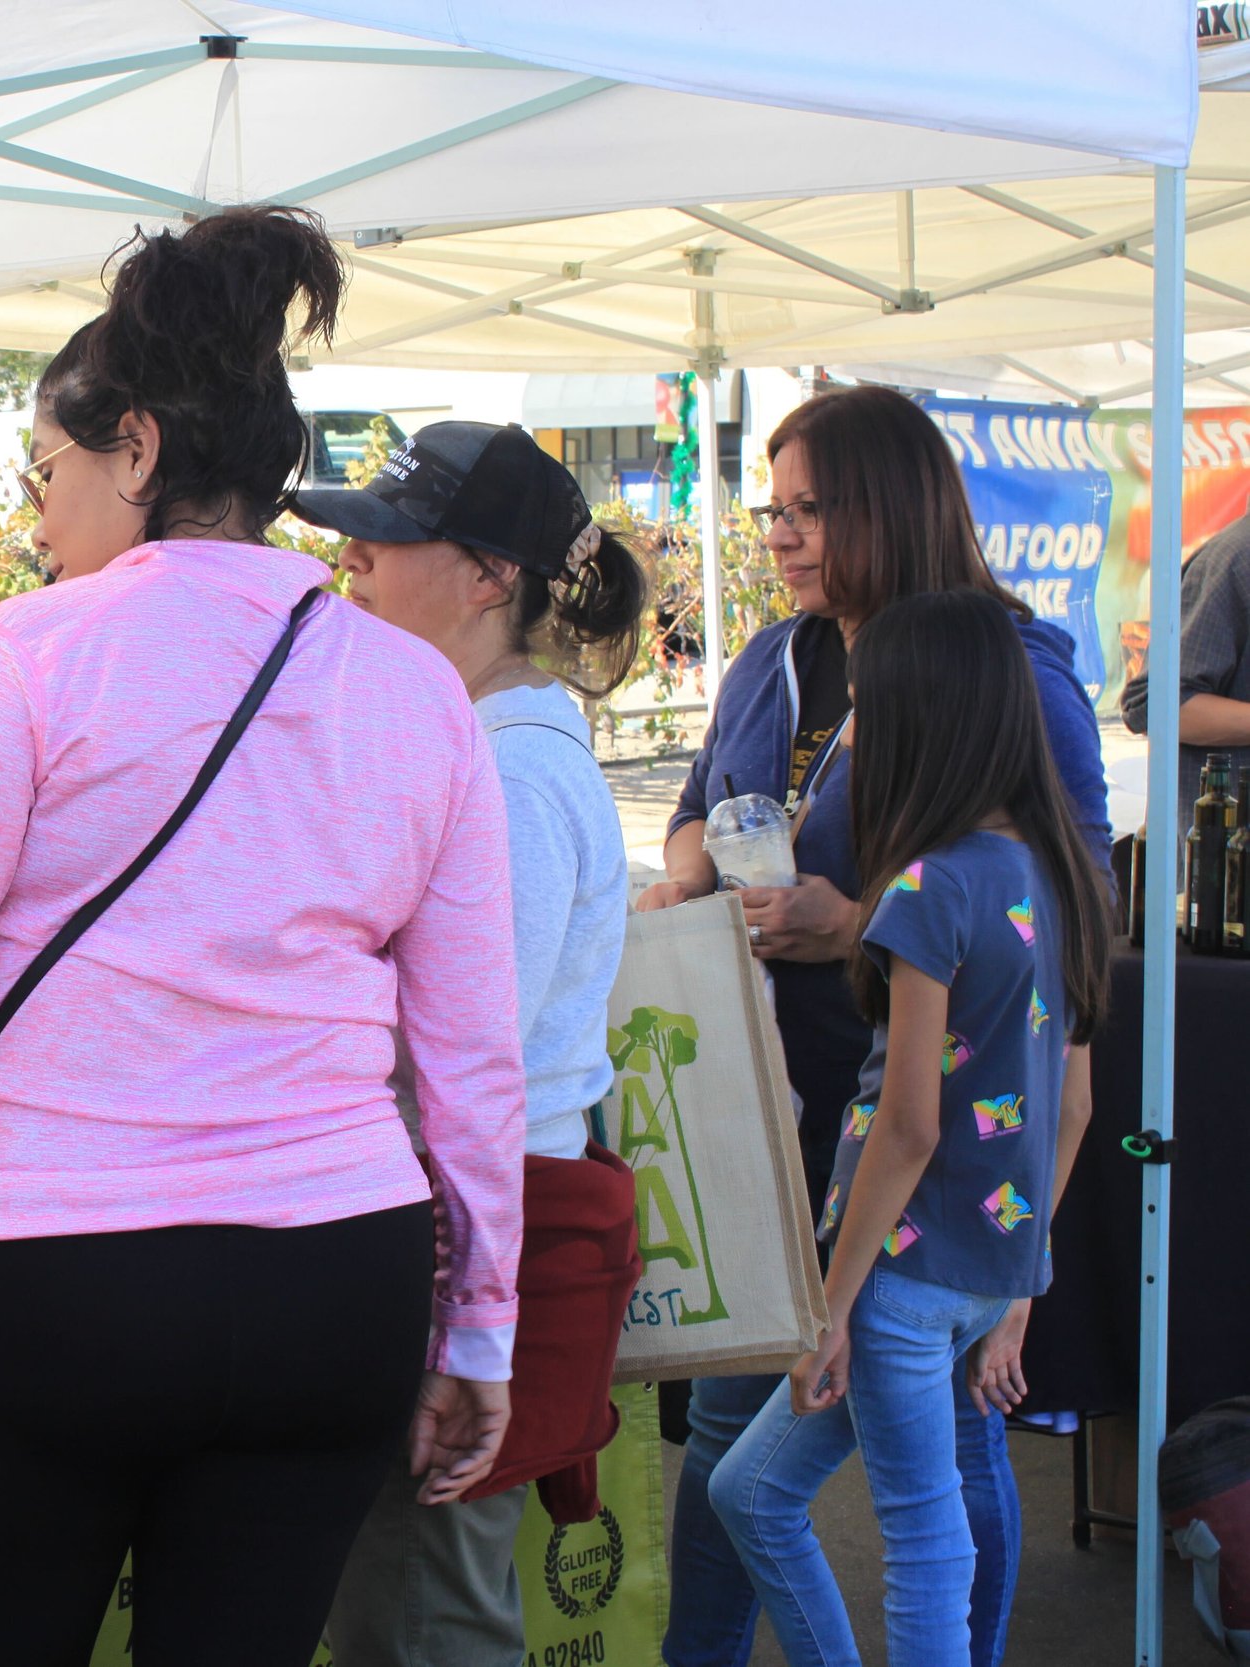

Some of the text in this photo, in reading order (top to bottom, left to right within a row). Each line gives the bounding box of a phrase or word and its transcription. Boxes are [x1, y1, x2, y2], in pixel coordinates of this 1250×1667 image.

[989, 415, 1126, 471] AWAY
[977, 524, 1102, 571] AFOOD
[973, 1093, 1024, 1129] MTV
[622, 1288, 682, 1332] EST
[559, 1544, 612, 1573] GLUTEN
[571, 1570, 602, 1595] FREE
[544, 1630, 605, 1667] 92840
